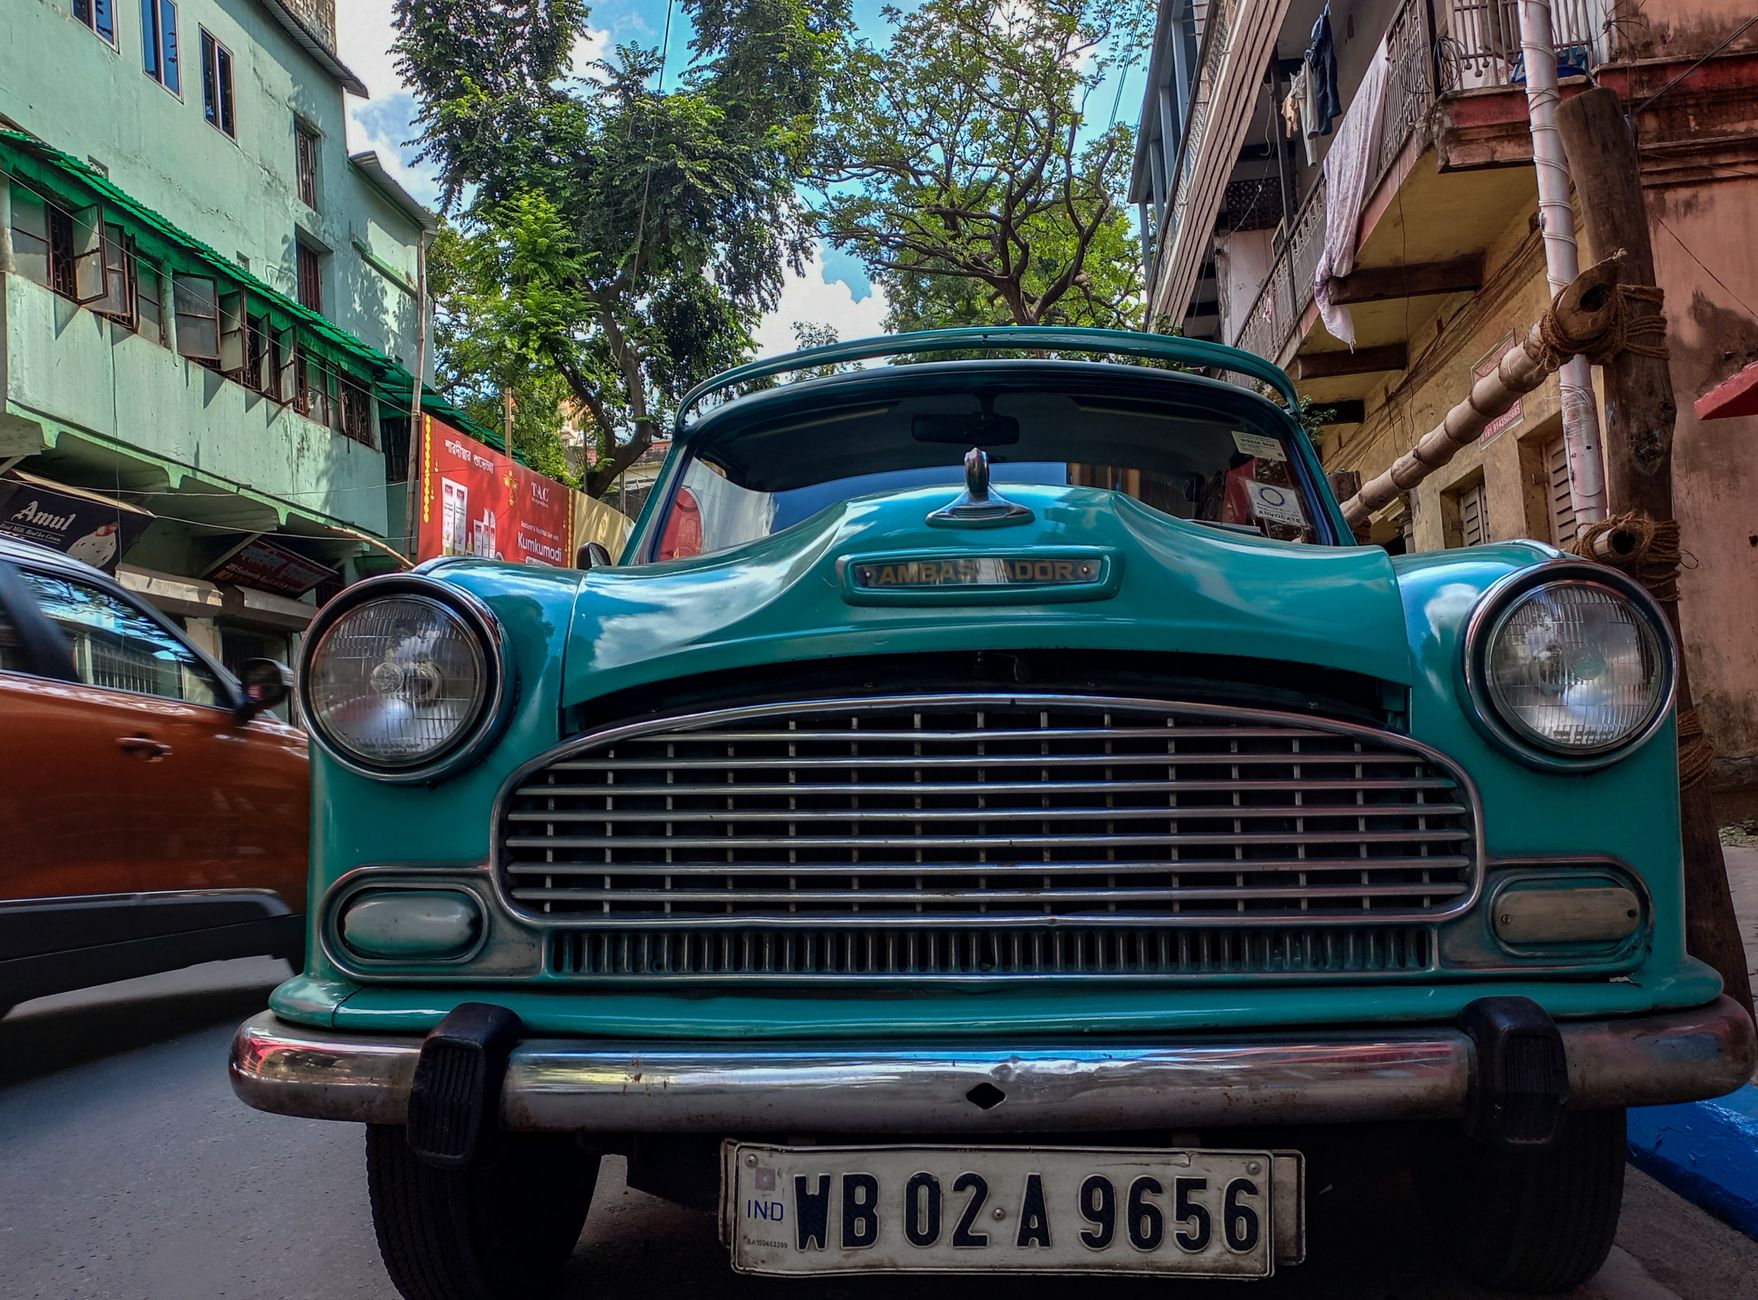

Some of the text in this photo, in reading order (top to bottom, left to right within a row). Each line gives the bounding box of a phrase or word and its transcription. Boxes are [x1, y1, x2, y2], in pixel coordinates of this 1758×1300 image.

[531, 481, 550, 502] TAC
[11, 500, 77, 531] Amul
[518, 531, 562, 562] Kumkumadi
[879, 559, 1074, 584] AMBASADOR
[747, 1199, 784, 1222] IND
[793, 1171, 1260, 1254] WB 02 A 9656
